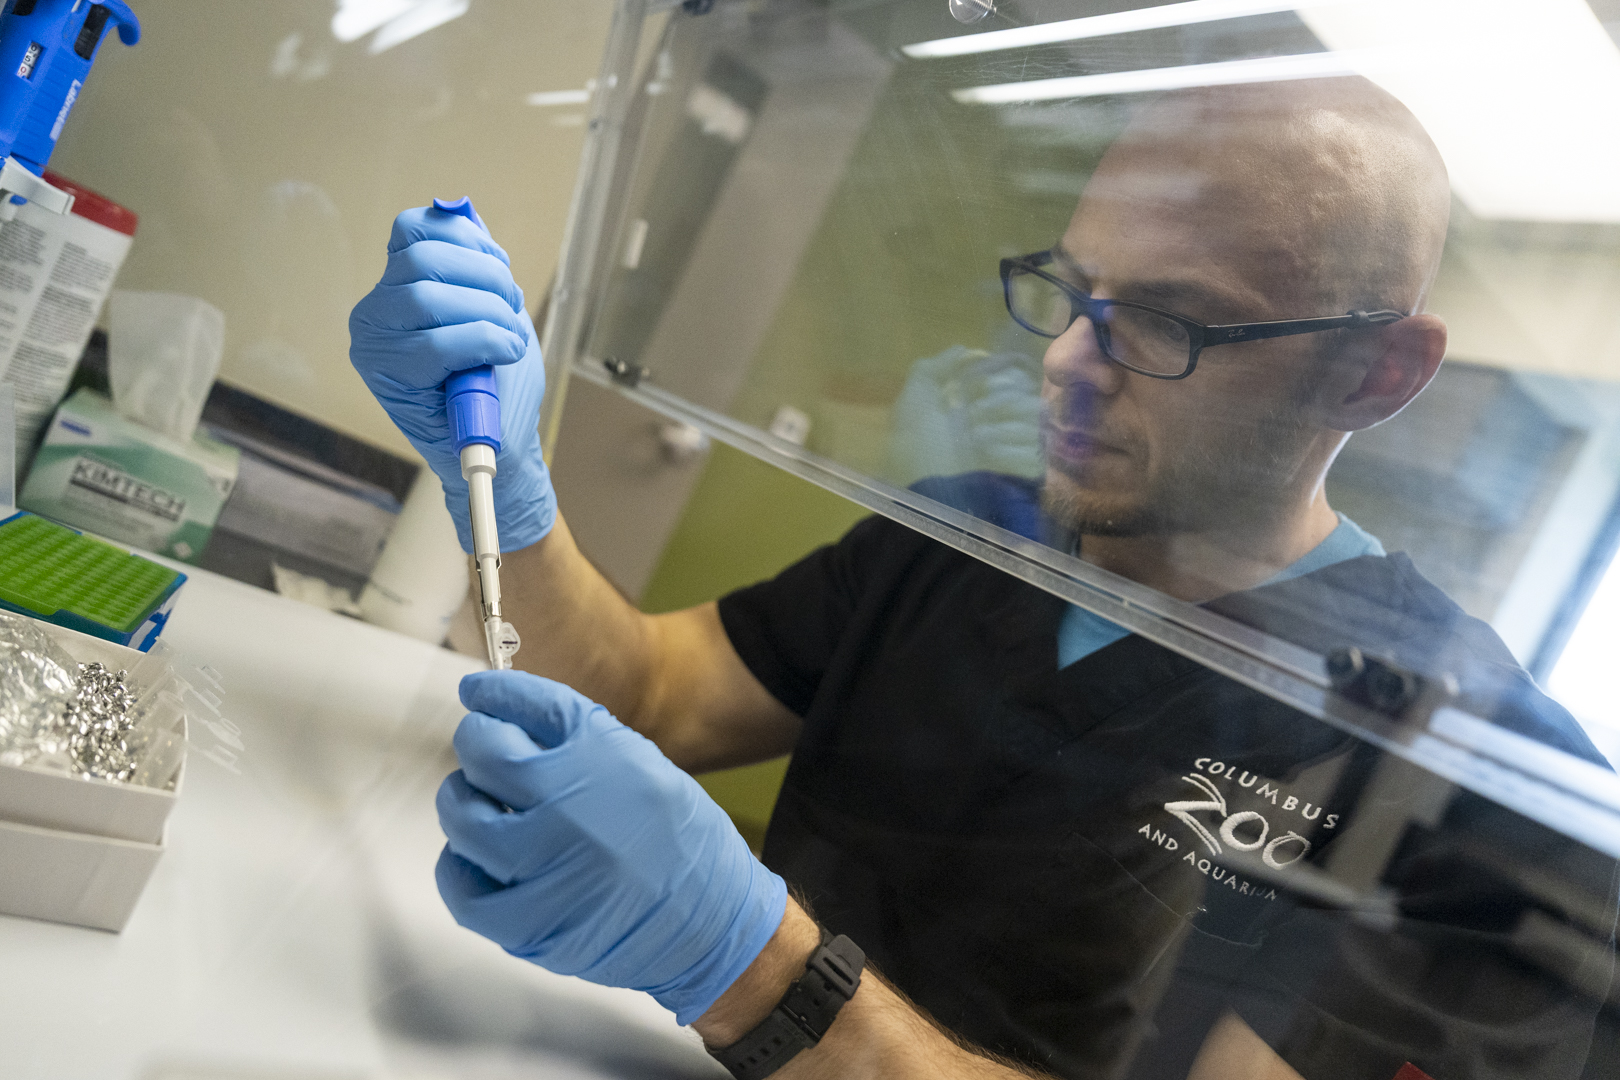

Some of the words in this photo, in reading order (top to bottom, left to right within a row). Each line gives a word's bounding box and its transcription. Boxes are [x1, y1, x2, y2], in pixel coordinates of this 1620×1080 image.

[72, 461, 187, 516] KIMTECH
[1164, 772, 1312, 871] ZOO
[1194, 757, 1340, 829] COLUMBUS
[1138, 823, 1178, 850] AND
